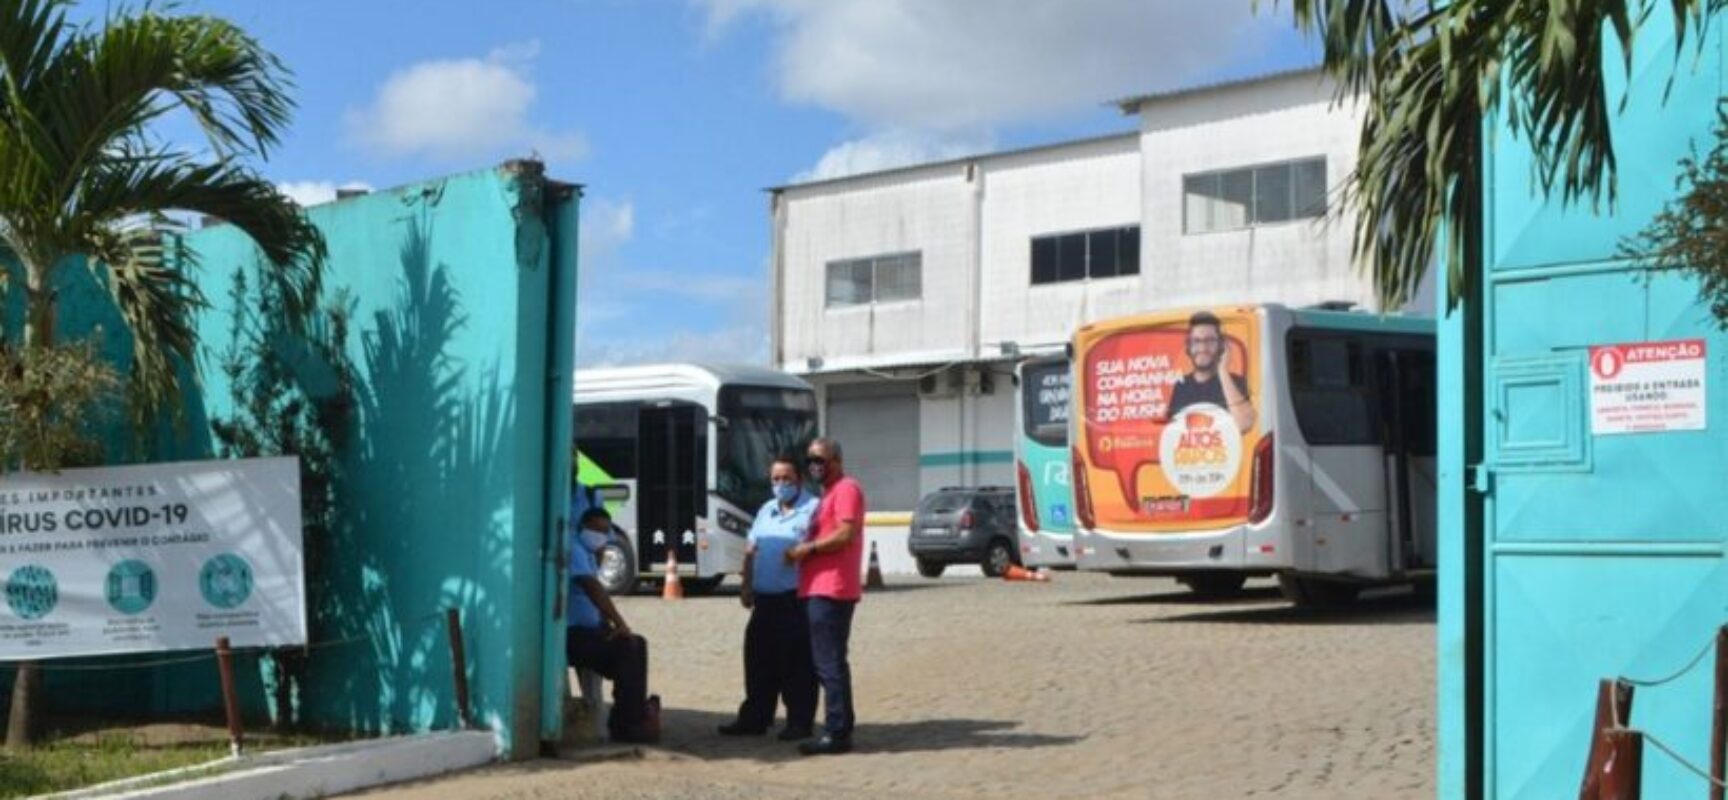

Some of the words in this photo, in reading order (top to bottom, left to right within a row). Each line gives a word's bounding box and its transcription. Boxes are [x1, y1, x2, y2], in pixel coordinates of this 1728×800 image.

[1626, 342, 1700, 361] ATENÇÃO
[1096, 360, 1124, 374] SUA
[1127, 355, 1170, 371] NOVA
[1096, 370, 1185, 391] COMPANHIA
[1653, 378, 1699, 389] ENTRADA
[1097, 392, 1118, 406] NA
[1122, 388, 1164, 404] HORA
[1097, 407, 1120, 422] DO
[1179, 432, 1223, 449] ALTOS
[29, 486, 157, 503] IMPORTANTES
[65, 503, 188, 531] COVID-19
